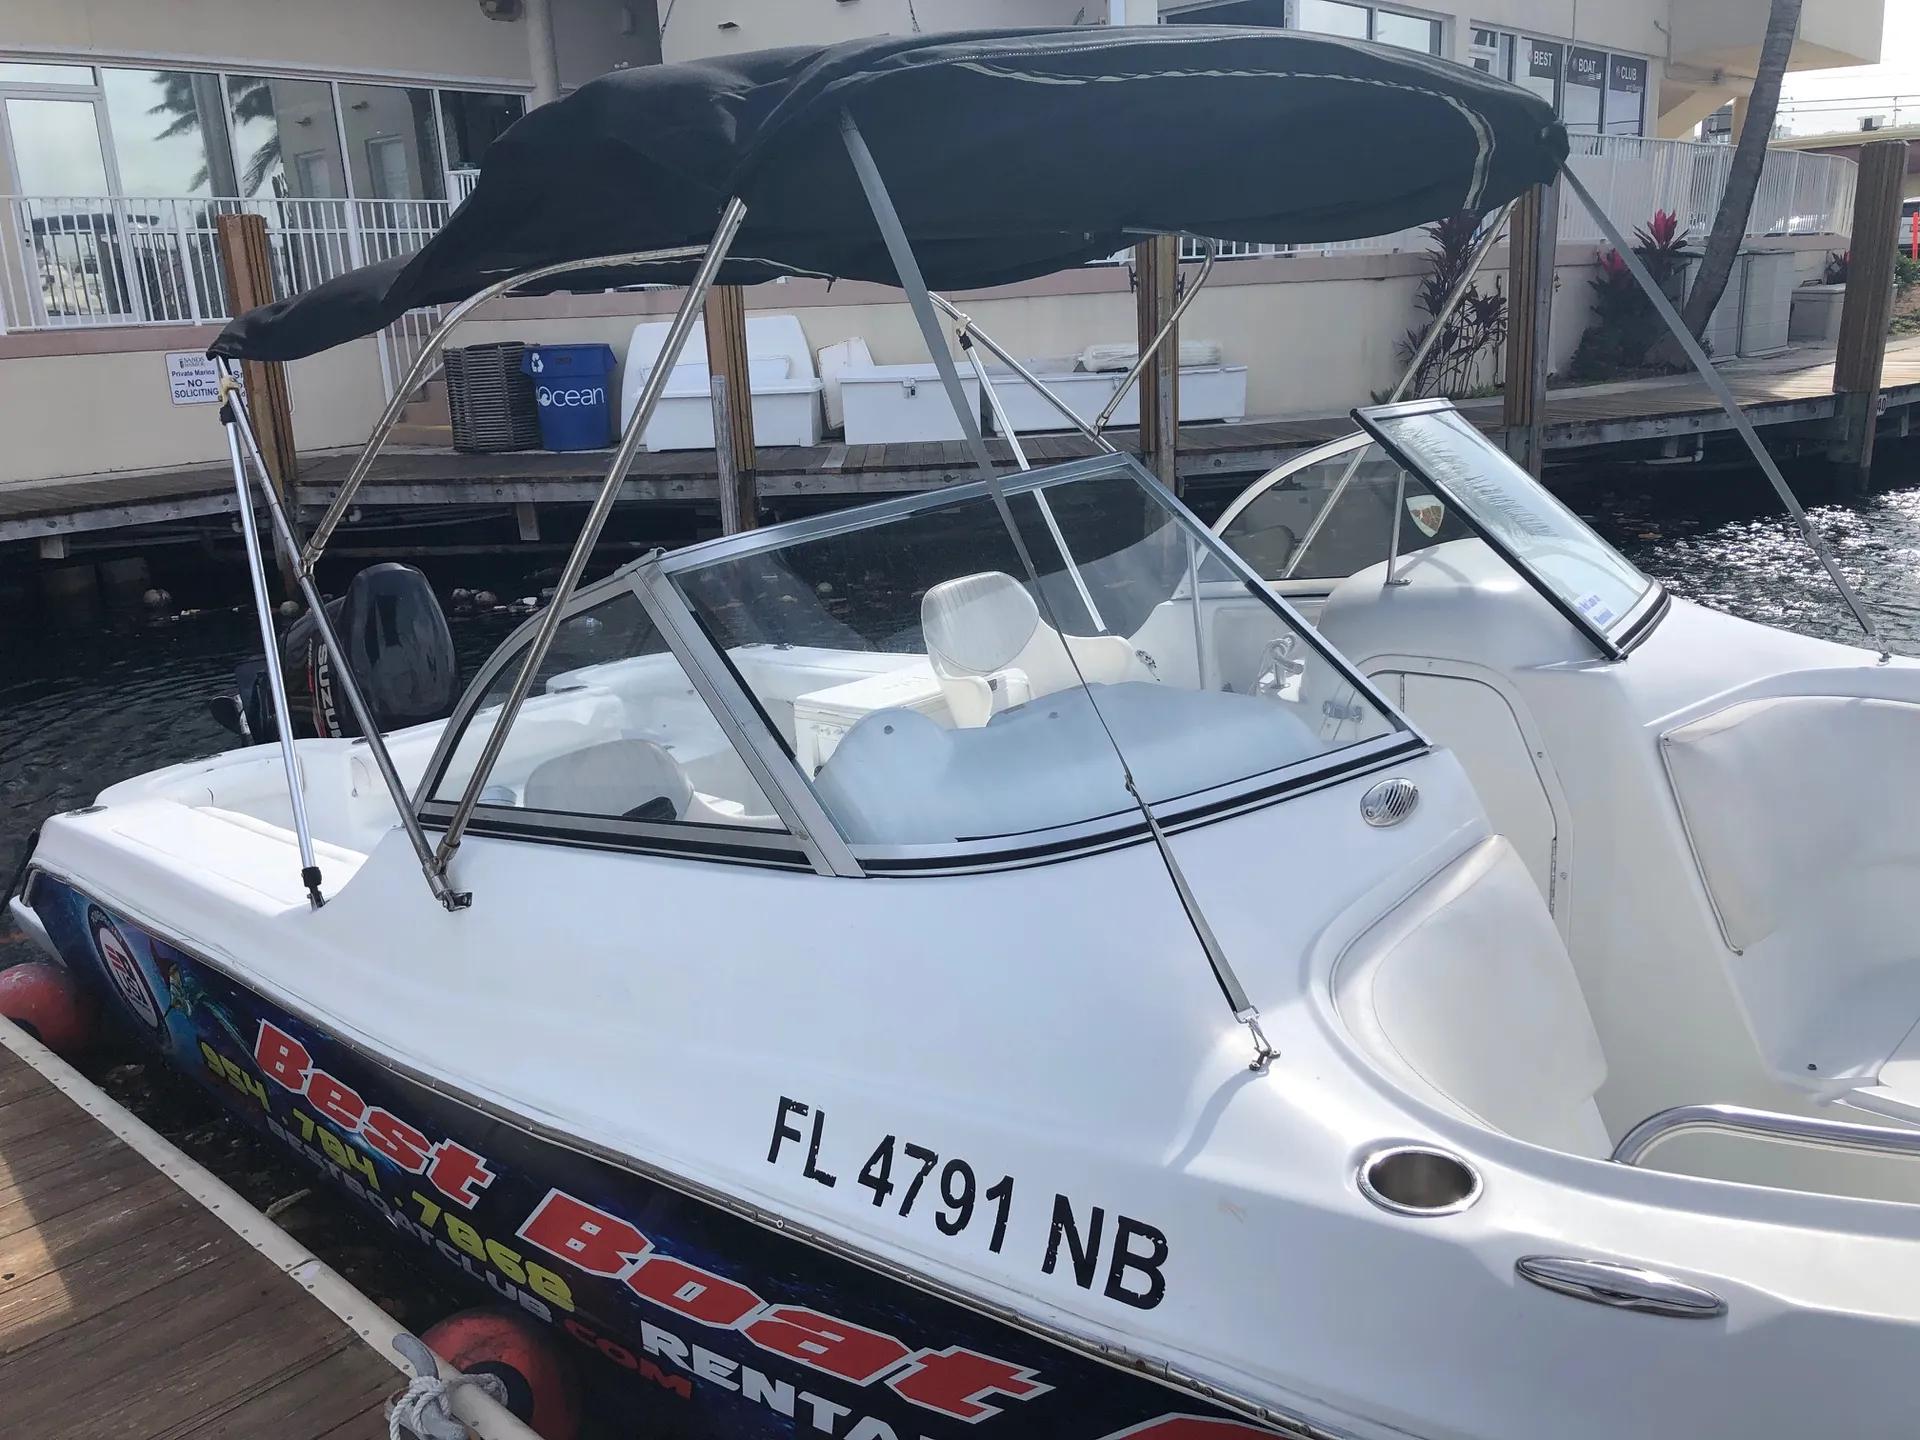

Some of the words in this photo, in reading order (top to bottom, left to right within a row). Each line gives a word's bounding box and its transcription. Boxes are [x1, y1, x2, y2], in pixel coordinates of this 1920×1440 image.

[1533, 50, 1553, 67] BEST
[1578, 58, 1597, 74] BOAT
[1620, 66, 1637, 81] CLUB
[174, 387, 220, 399] SOLICITING
[187, 378, 203, 388] NO
[254, 1018, 496, 1210] Best
[515, 1187, 1056, 1424] Boat
[766, 1095, 837, 1188] FL
[858, 1134, 1014, 1254] 4791
[1041, 1193, 1169, 1310] NB
[641, 1320, 936, 1440] RENTA
